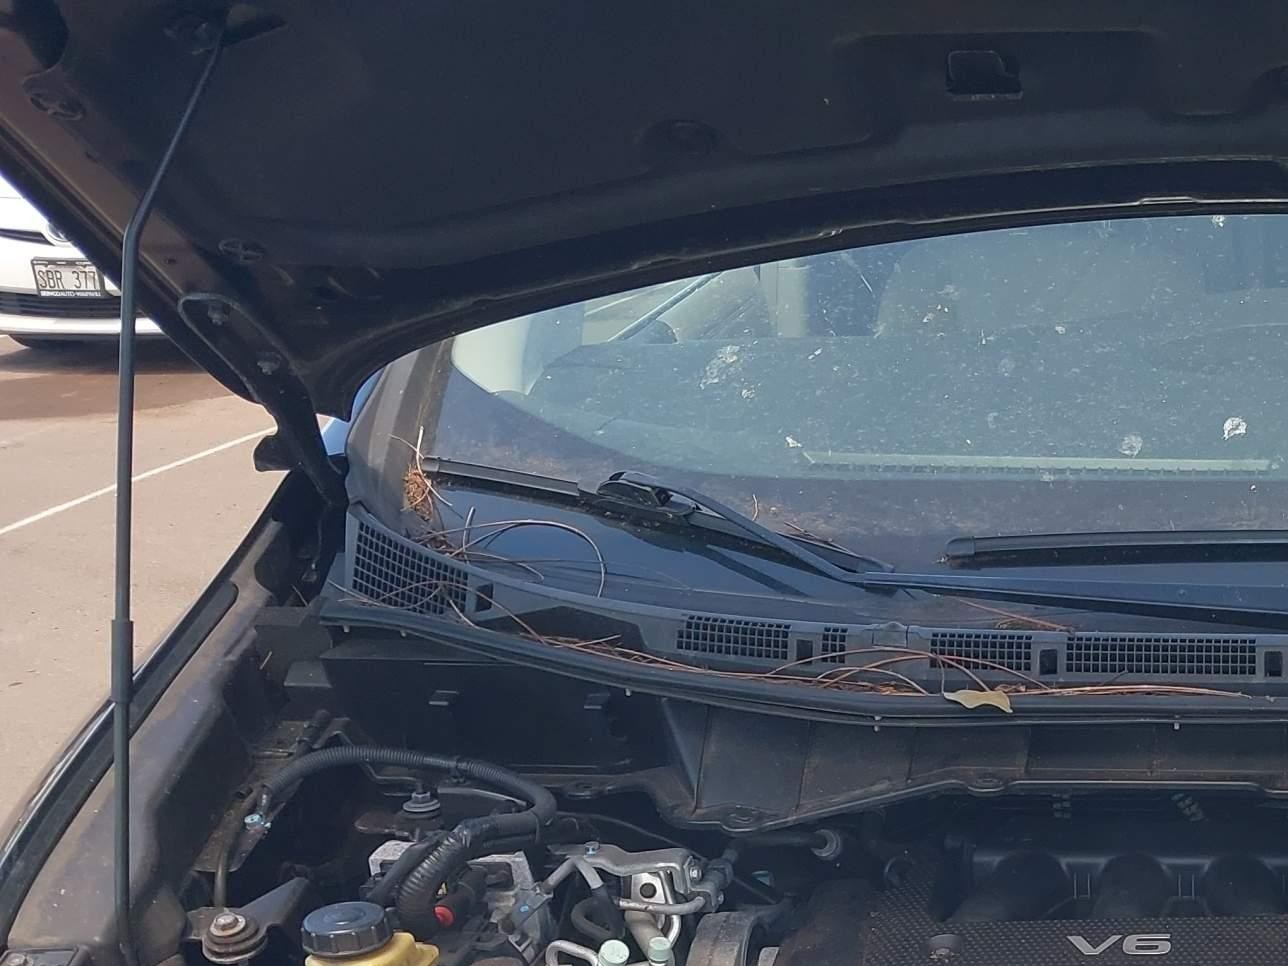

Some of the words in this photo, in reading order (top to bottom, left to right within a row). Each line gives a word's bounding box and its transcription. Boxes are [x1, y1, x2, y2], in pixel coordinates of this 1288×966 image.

[37, 270, 65, 289] SBR
[71, 270, 97, 290] 377
[1066, 933, 1172, 955] V6
